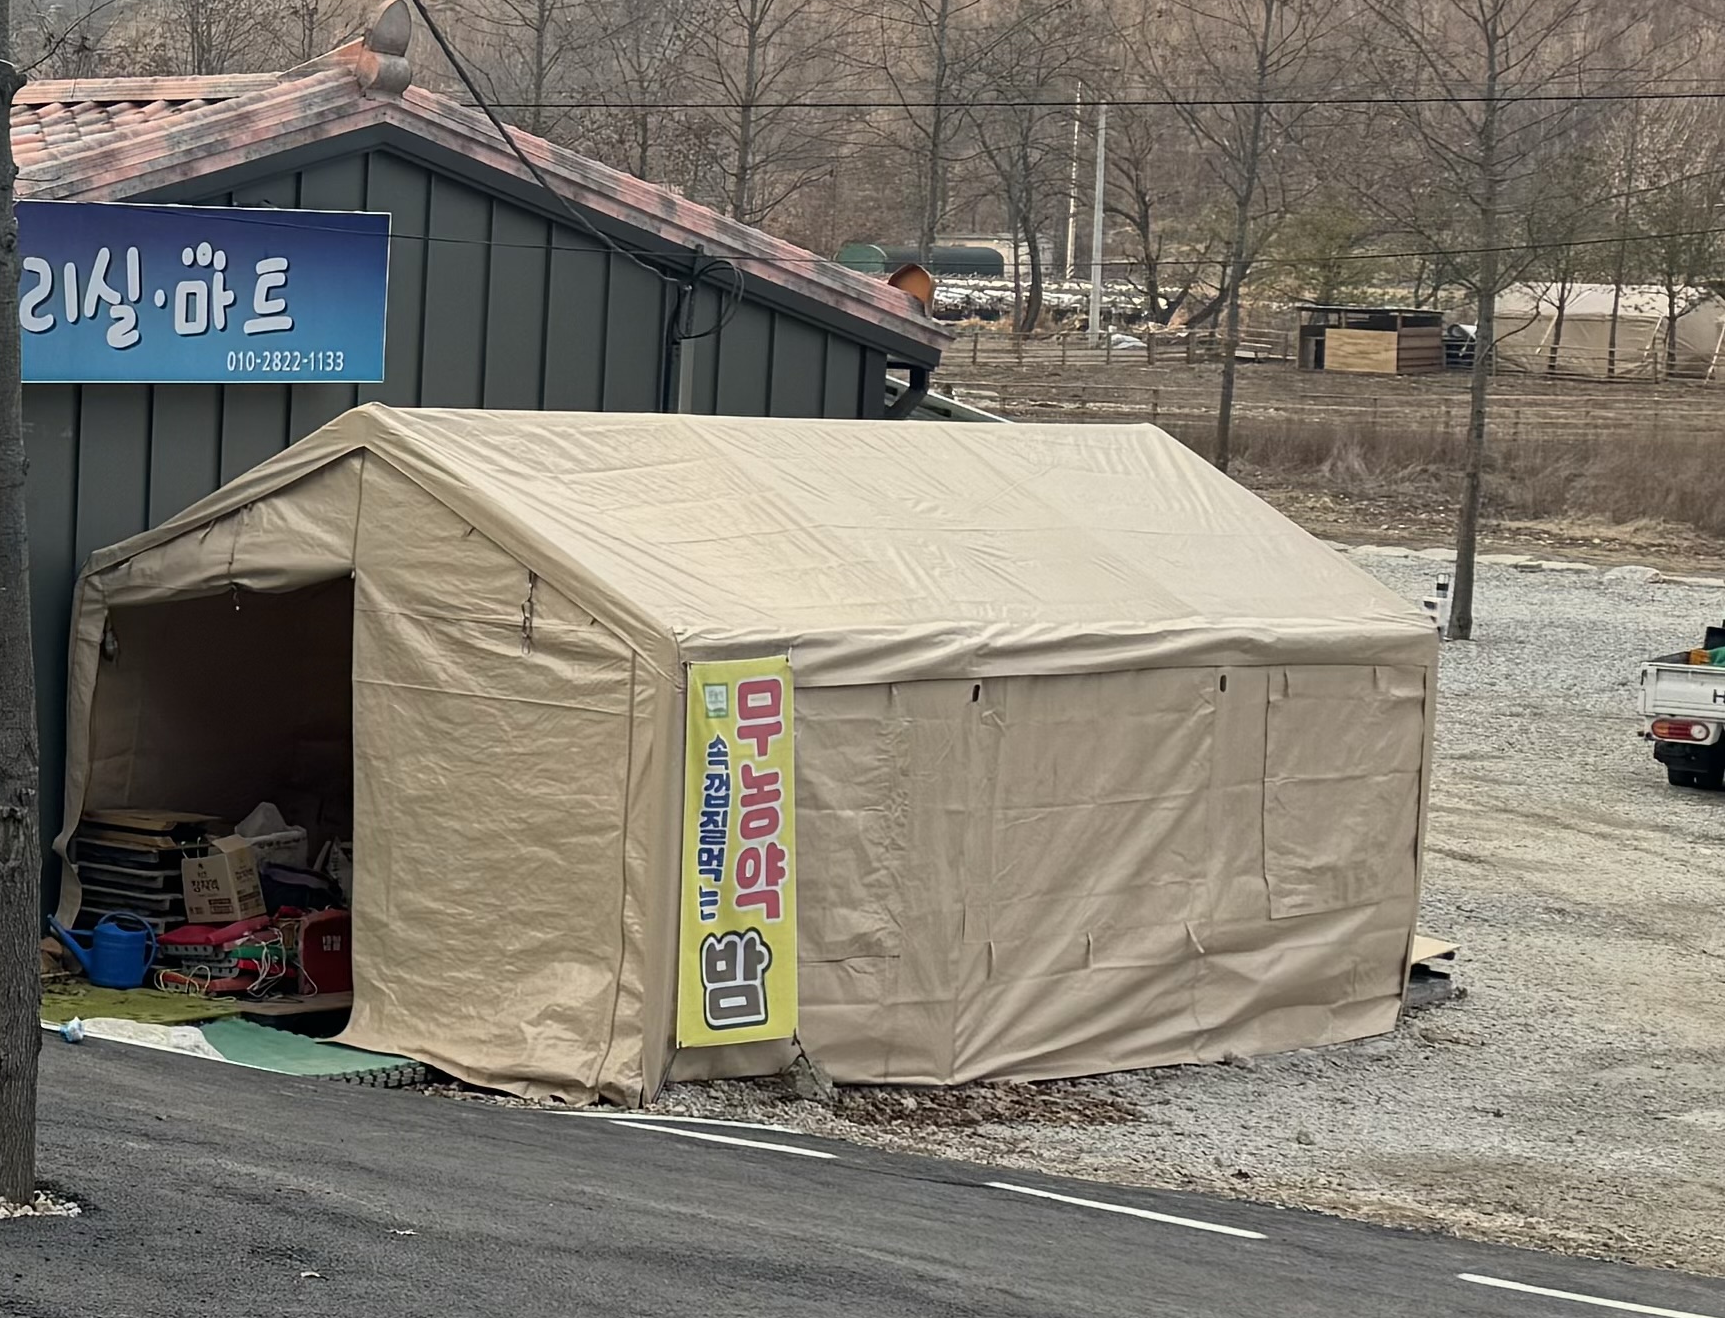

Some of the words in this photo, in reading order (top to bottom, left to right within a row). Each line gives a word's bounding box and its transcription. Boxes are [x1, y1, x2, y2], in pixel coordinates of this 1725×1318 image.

[226, 349, 345, 373] 010-2822-1133
[735, 679, 786, 920] 무농약
[701, 928, 771, 1028] 밤
